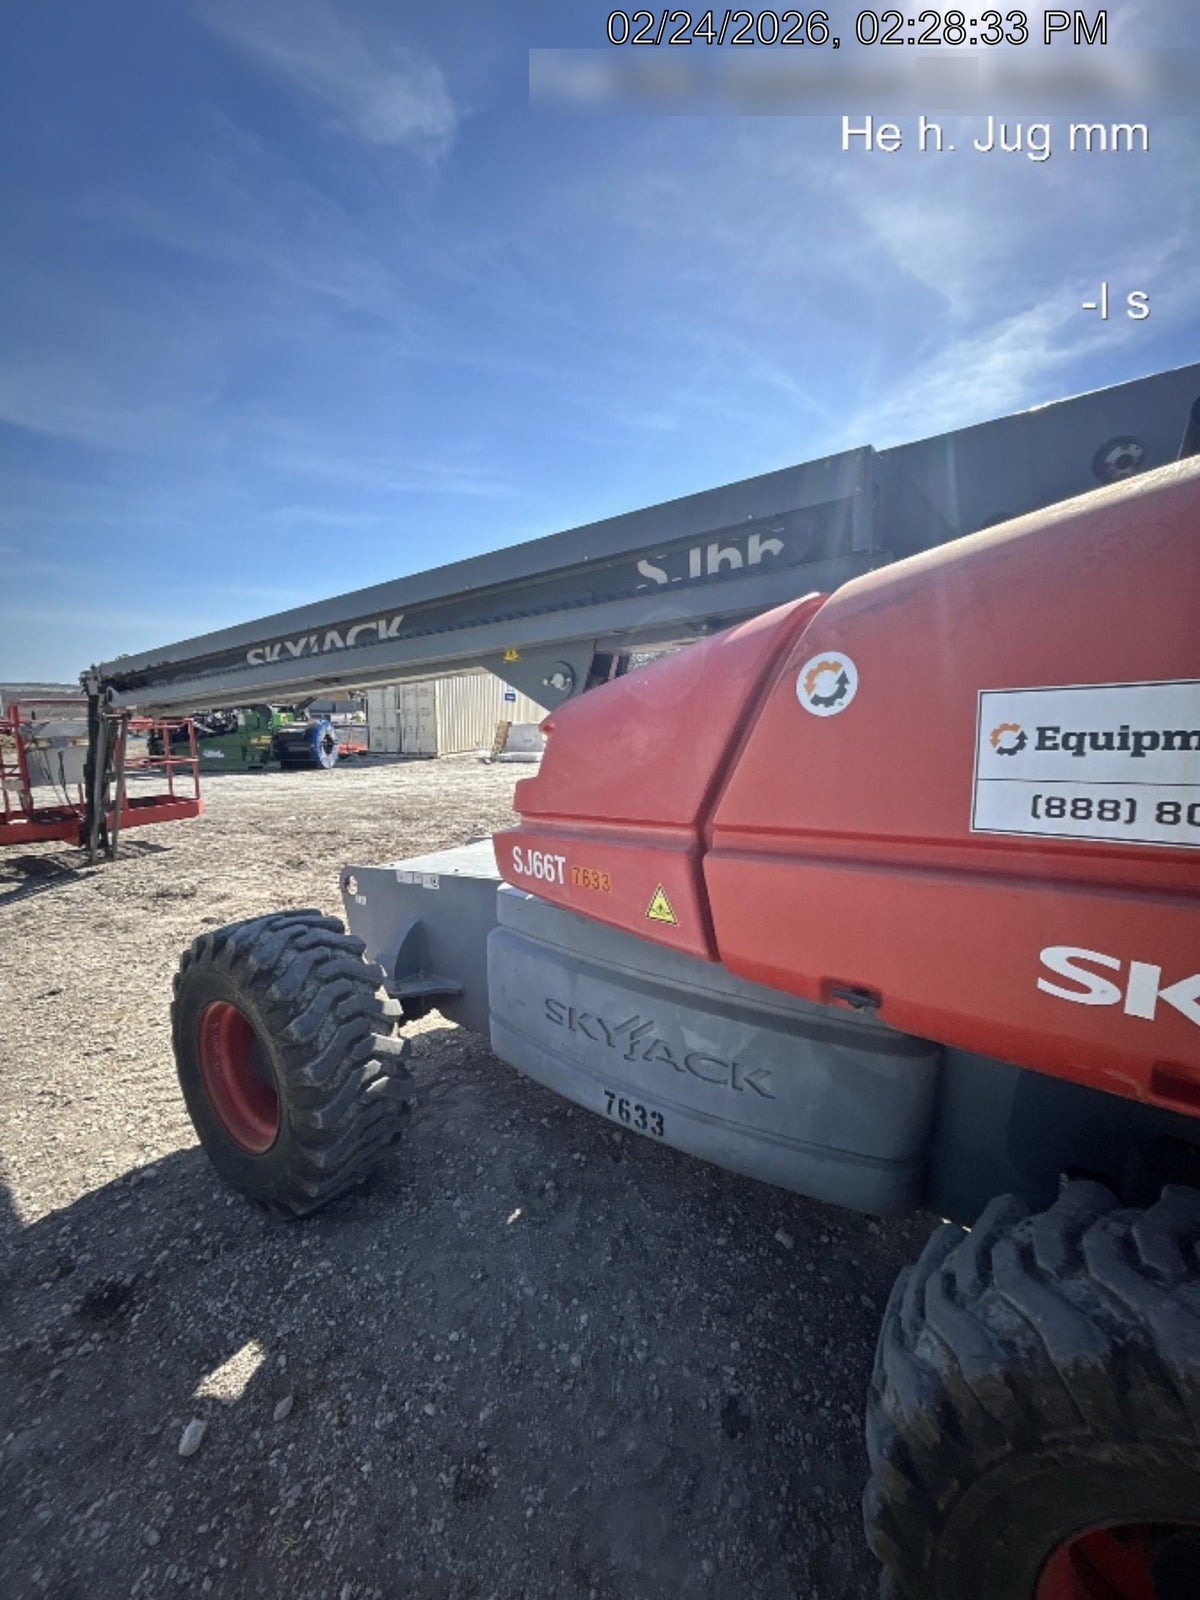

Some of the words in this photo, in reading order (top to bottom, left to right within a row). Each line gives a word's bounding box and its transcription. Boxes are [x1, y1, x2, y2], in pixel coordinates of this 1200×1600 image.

[1034, 724, 1200, 758] Equipm
[1030, 794, 1137, 825] (888)
[512, 845, 566, 885] SJ66T
[571, 866, 611, 892] 7633
[544, 997, 777, 1101] SKYJACK
[604, 1089, 666, 1138] 7633
